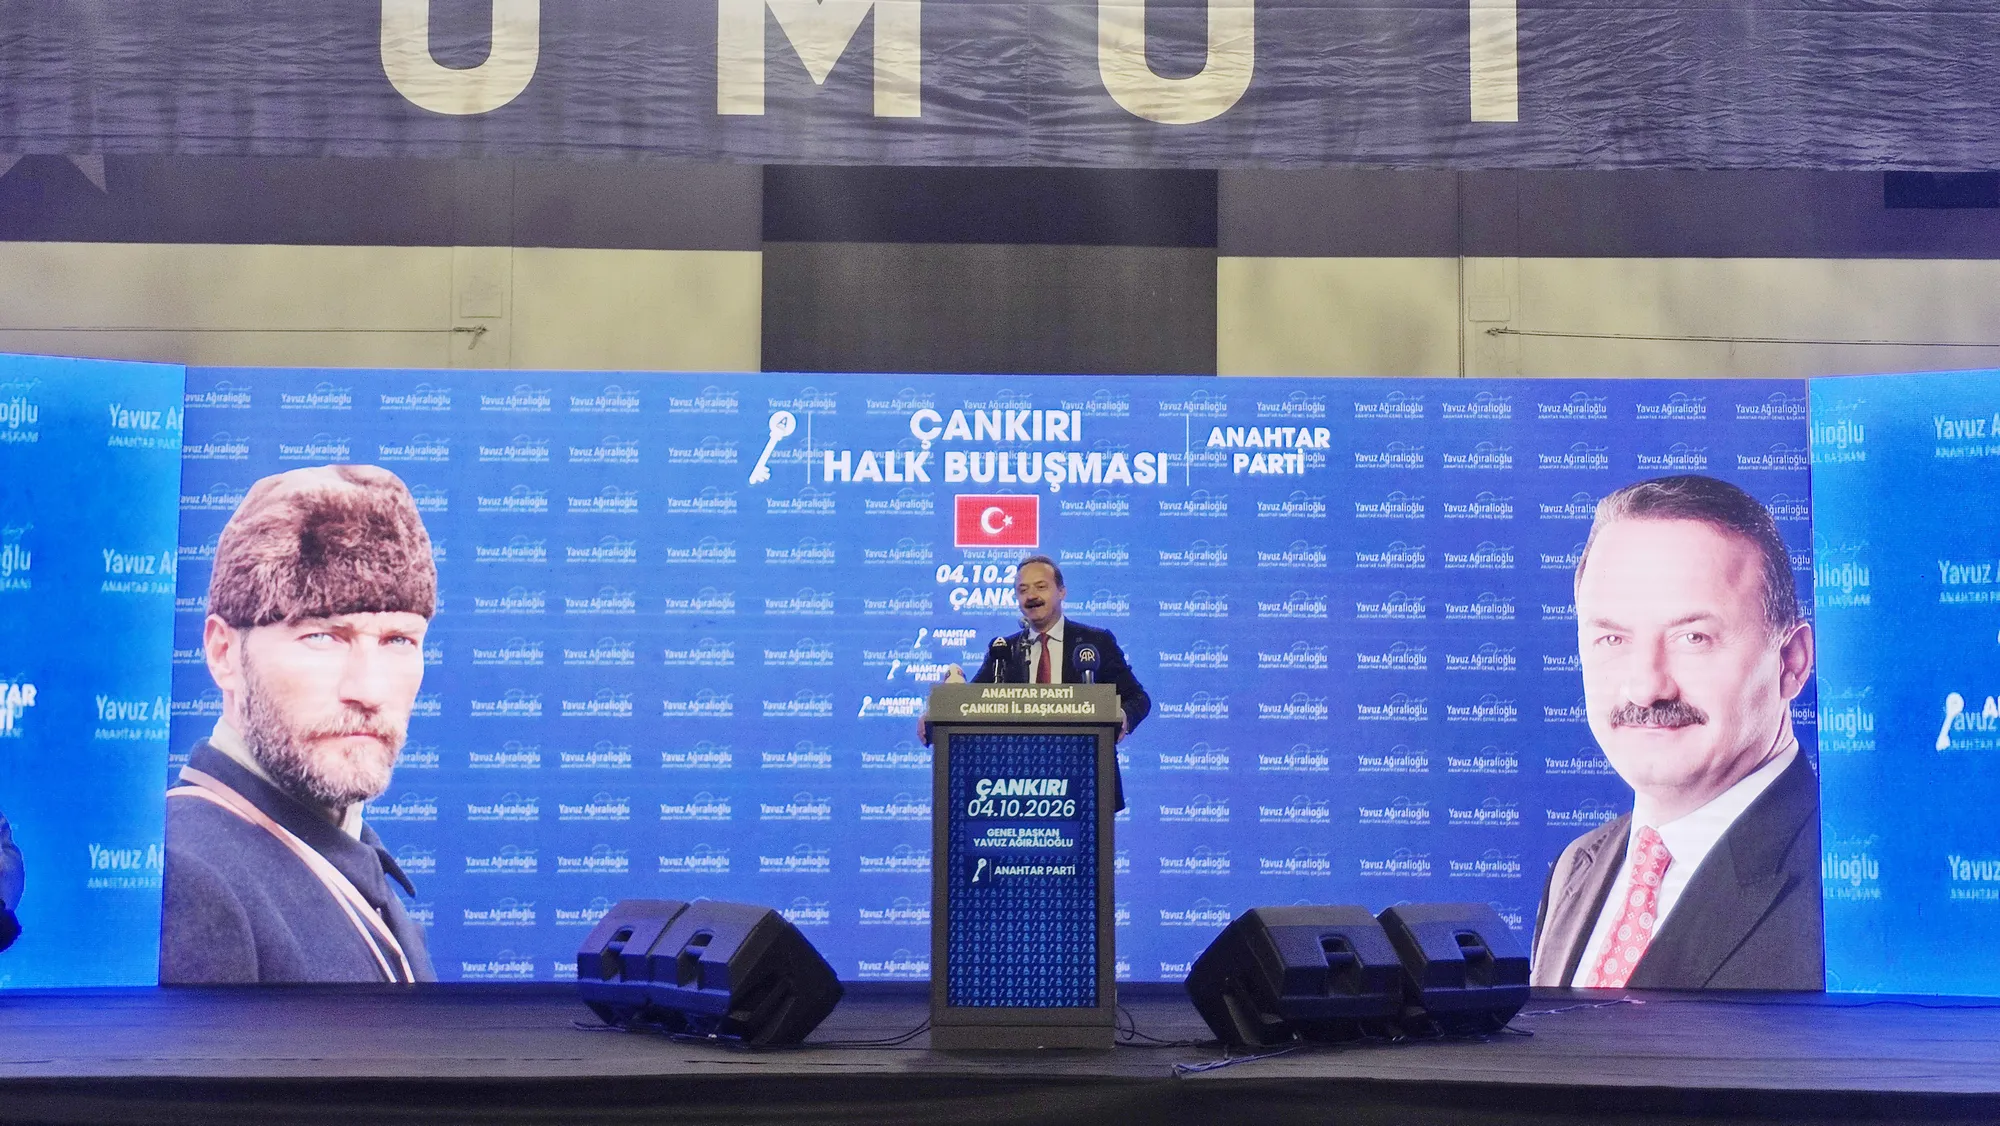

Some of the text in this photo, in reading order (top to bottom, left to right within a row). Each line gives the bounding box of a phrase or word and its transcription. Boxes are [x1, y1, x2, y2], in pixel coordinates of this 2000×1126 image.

[281, 393, 304, 403] Yavuz
[481, 395, 504, 405] Yavuz
[669, 397, 692, 407] Yavuz
[1060, 400, 1083, 410] Yavuz
[1256, 401, 1326, 414] Yavuz Ağıralioğlu
[1442, 402, 1512, 415] Yavuz Ağıralioğlu
[1537, 402, 1607, 415] Yavuz Ağıralioğlu
[1636, 402, 1706, 415] Yavuz Ağıralioğlu
[109, 403, 162, 430] Yavuz
[909, 407, 1081, 450] ÇANKIRI
[1933, 414, 1986, 440] Yavuz
[1206, 426, 1330, 448] ANAHTAR
[379, 445, 402, 455] Yavuz
[569, 447, 592, 457] Yavuz
[1232, 447, 1304, 474] PARTİ
[1354, 452, 1424, 465] Yavuz Ağıralioğlu
[1538, 452, 1608, 465] Yavuz Ağıralioğlu
[1737, 454, 1760, 464] Yavuz
[1762, 453, 1807, 466] Ağıralioğlu
[823, 449, 1168, 492] HALK BULUŞMASI
[478, 496, 501, 506] Yavuz
[667, 497, 690, 507] Yavuz
[864, 499, 887, 509] Yavuz
[1060, 500, 1083, 510] Yavuz
[1256, 501, 1326, 514] Yavuz Ağıralioğlu
[1443, 502, 1513, 515] Yavuz Ağıralioğlu
[566, 547, 589, 557] Yavuz
[765, 548, 788, 558] Yavuz
[1158, 549, 1228, 562] Yavuz Ağıralioğlu
[1355, 551, 1425, 564] Yavuz Ağıralioğlu
[103, 548, 156, 575] Yavuz
[936, 564, 1018, 584] 04.10.2
[1938, 560, 1991, 585] Yavuz
[863, 599, 886, 609] Yavuz
[949, 587, 1019, 611] ÇANK
[1257, 601, 1327, 614] Yavuz Ağıralioğlu
[1445, 602, 1515, 615] Yavuz Ağıralioğlu
[932, 629, 976, 638] ANAHTAR
[1159, 651, 1229, 664] Yavuz Ağıralioğlu
[1357, 652, 1427, 665] Yavuz Ağıralioğlu
[981, 686, 1074, 699] ANAHTAR PARTİ
[95, 694, 149, 721] Yavuz
[879, 697, 923, 706] ANAHTAR
[960, 701, 1096, 716] ÇANKIRI İL BAŞKANLIĞI
[1258, 702, 1328, 715] Yavuz Ağıralioğlu
[1447, 704, 1517, 717] Yavuz Ağıralioğlu
[1953, 711, 1997, 732] avuz
[1159, 753, 1229, 766] Yavuz Ağıralioğlu
[1358, 755, 1428, 768] Yavuz Ağıralioğlu
[975, 778, 1069, 801] ÇANKIRI
[468, 804, 491, 814] Yavuz
[660, 804, 683, 814] Yavuz
[860, 804, 883, 814] Yavuz
[967, 799, 1076, 818] 04.10.2026
[1259, 805, 1329, 818] Yavuz Ağıralioğlu
[1449, 808, 1519, 821] Yavuz Ağıralioğlu
[986, 828, 1060, 839] GENEL BAŞKAN
[973, 838, 1007, 847] YAVUZ
[88, 843, 142, 870] Yavuz
[558, 856, 581, 866] Yavuz
[760, 856, 783, 866] Yavuz
[1160, 856, 1230, 869] Yavuz Ağıralioğlu
[994, 863, 1075, 875] ANAHTAR PARTİ
[1360, 859, 1430, 872] Yavuz Ağıralioğlu
[1948, 855, 2000, 881] Yavuz
[464, 909, 487, 919] Yavuz
[859, 908, 882, 918] Yavuz
[463, 961, 486, 971] Yavuz
